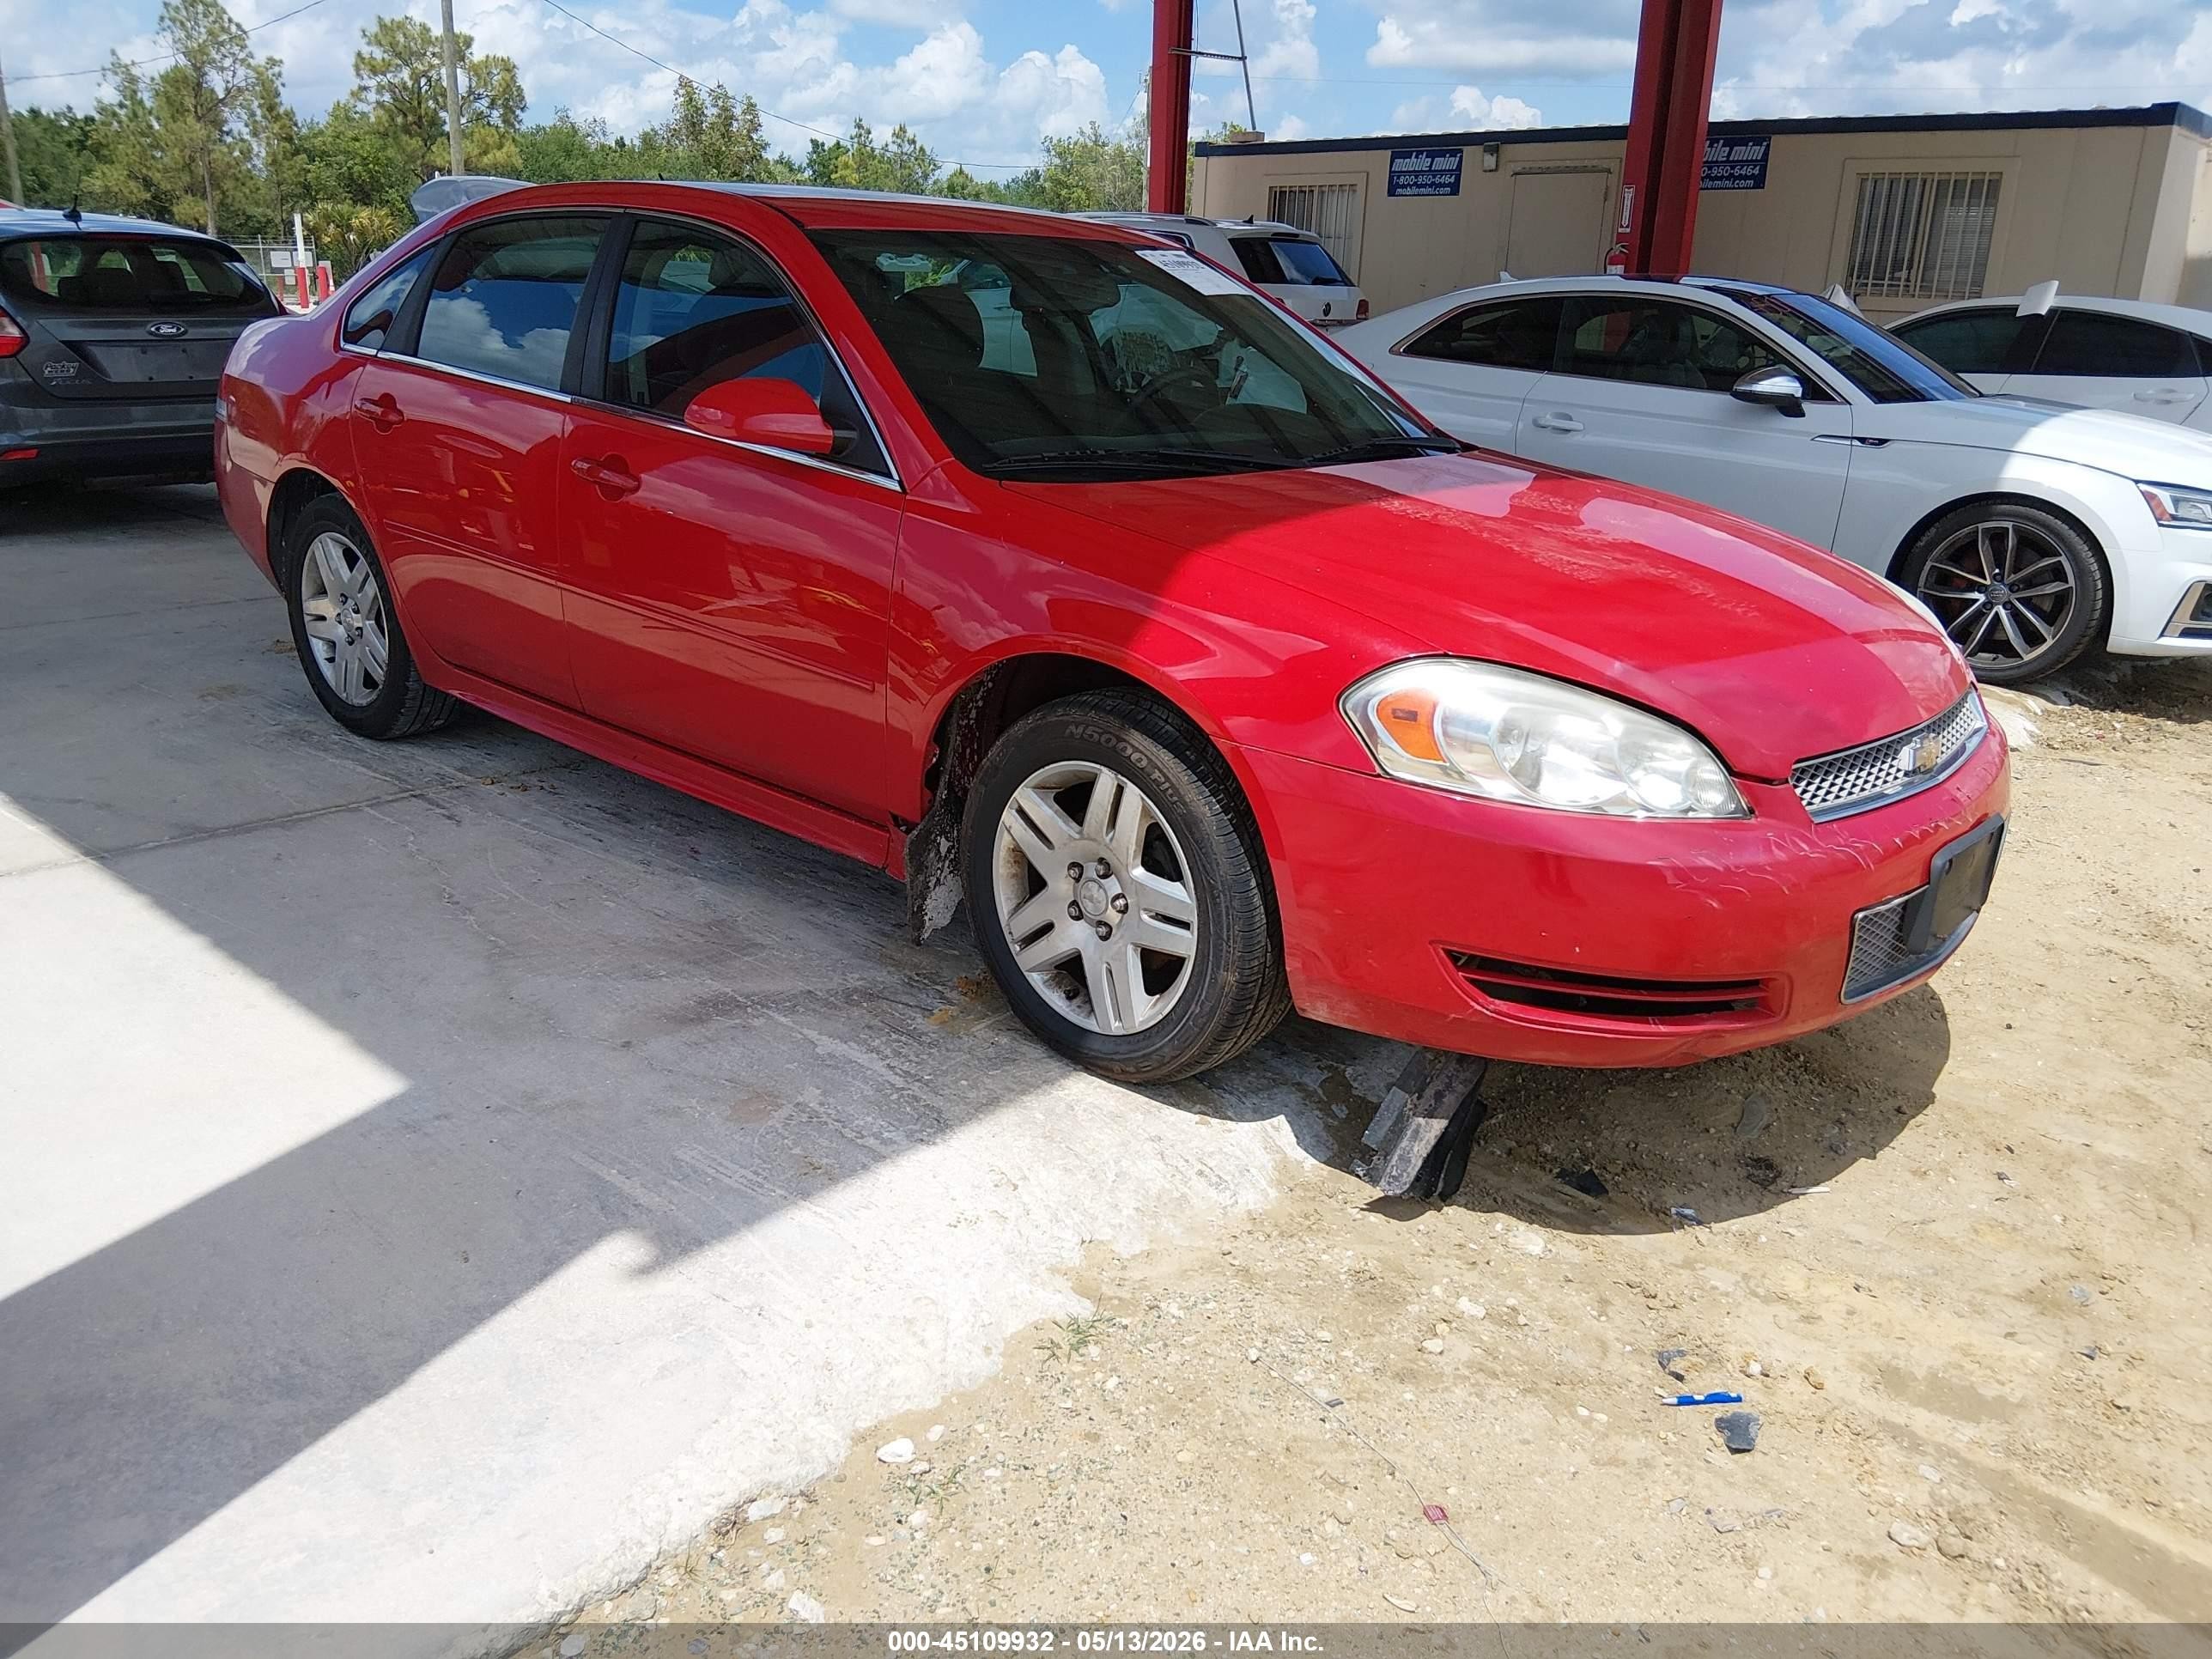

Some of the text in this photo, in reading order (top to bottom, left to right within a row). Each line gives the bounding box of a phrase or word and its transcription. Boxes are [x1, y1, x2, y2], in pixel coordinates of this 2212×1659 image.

[1391, 151, 1460, 171] mobile mini
[1729, 142, 1767, 161] mini
[1393, 174, 1455, 185] 1-800-950-6464
[1395, 186, 1451, 195] mobilemini.com
[1065, 722, 1148, 769] N5000
